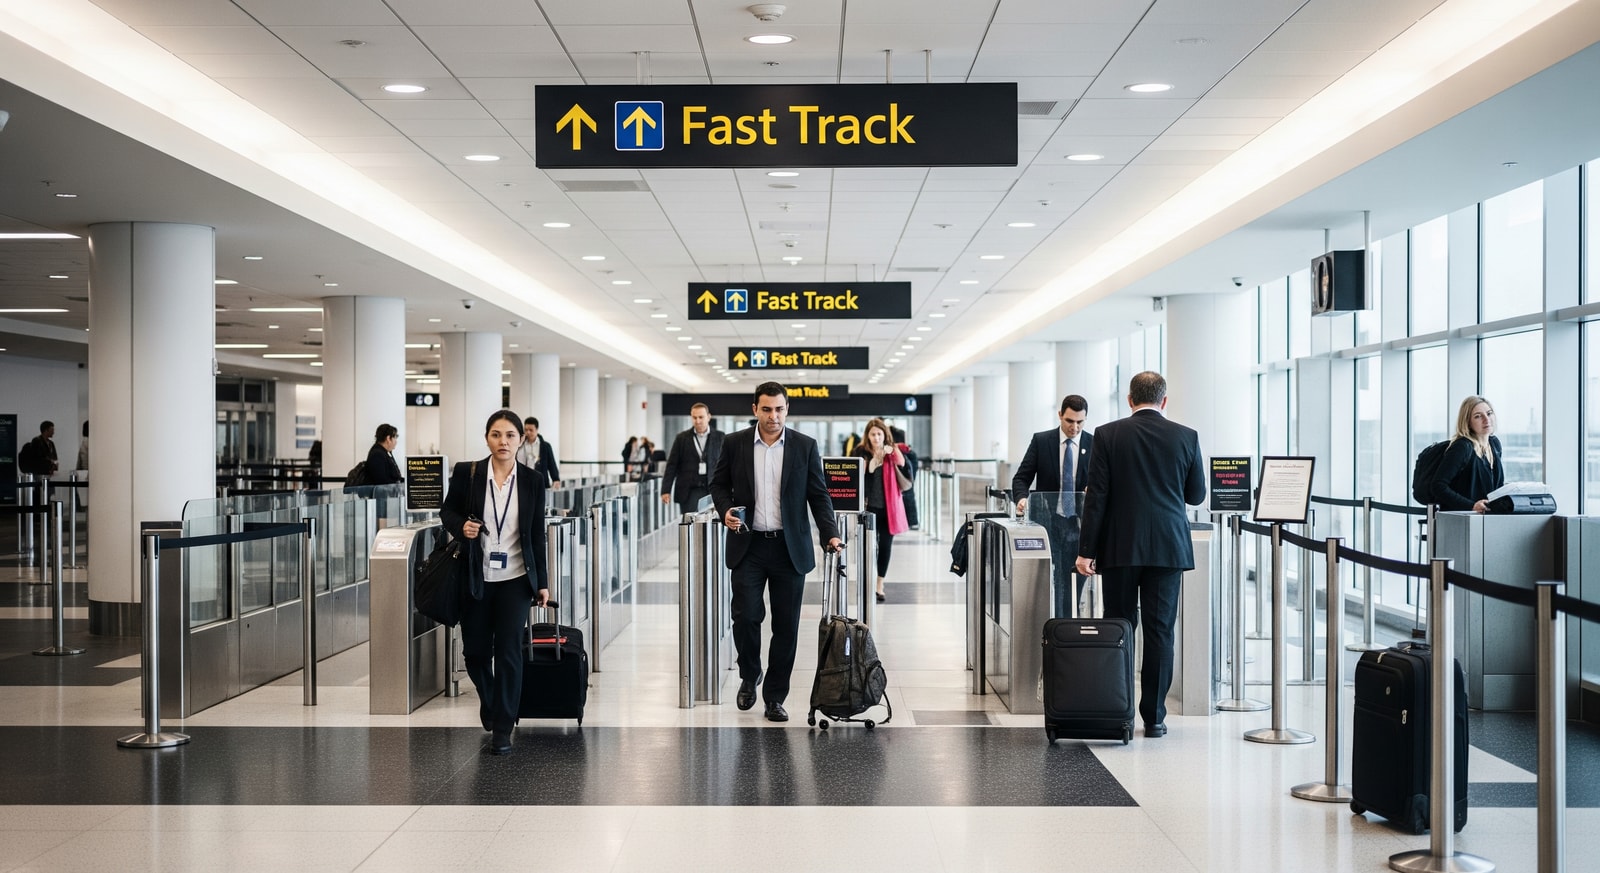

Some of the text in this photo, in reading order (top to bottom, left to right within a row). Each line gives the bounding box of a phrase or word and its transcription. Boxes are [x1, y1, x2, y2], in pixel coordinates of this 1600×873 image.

[683, 102, 916, 145] Fast Track
[757, 290, 858, 310] Fast Track
[771, 351, 838, 366] Fast Track
[786, 386, 830, 398] ast Track
